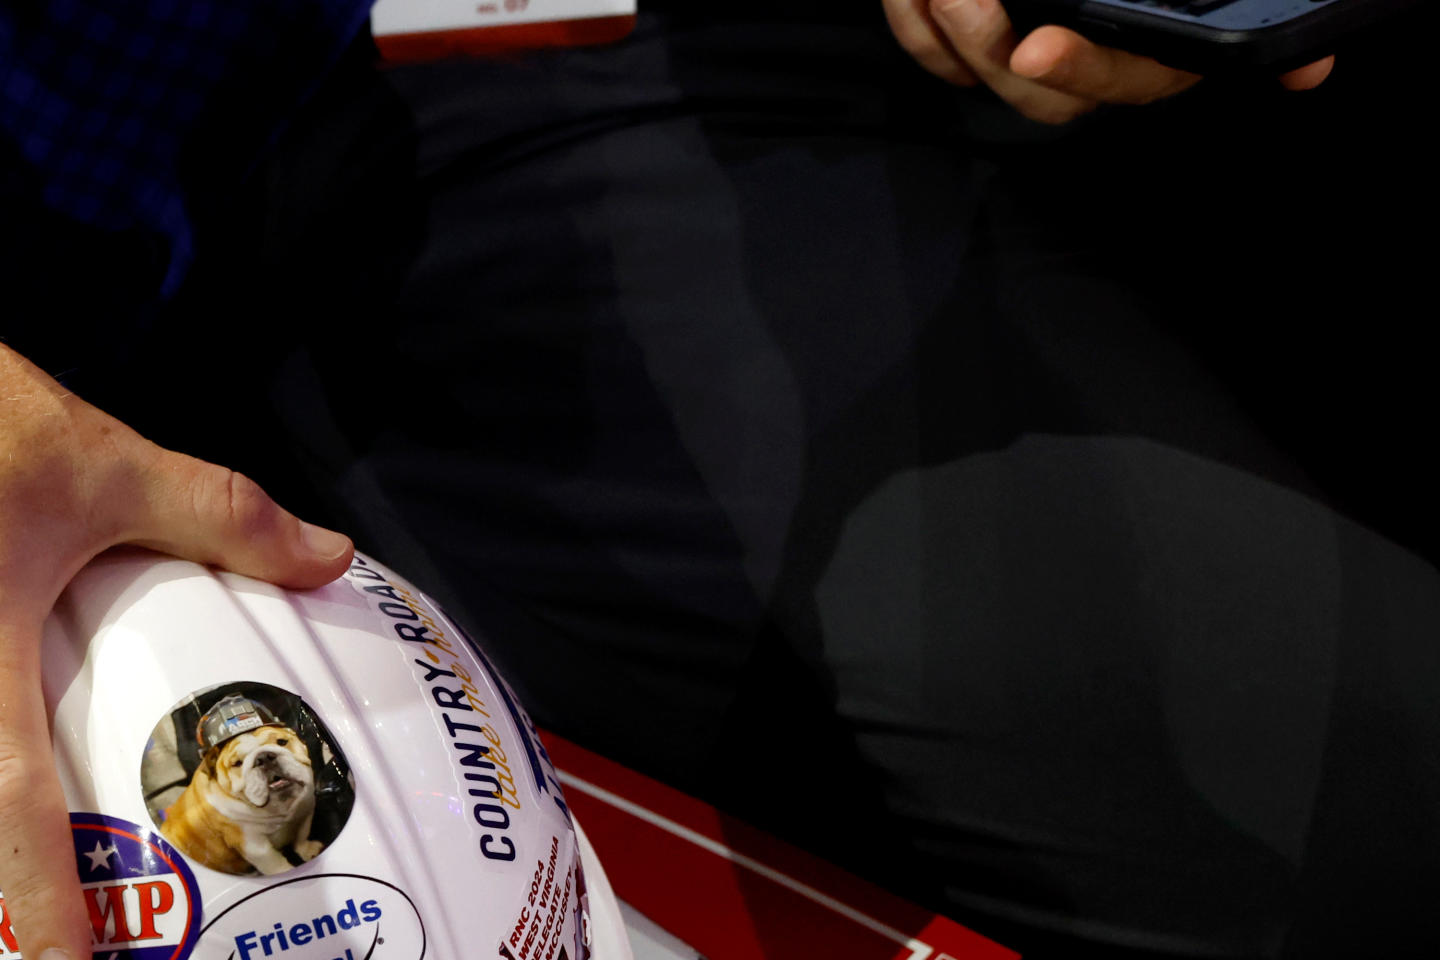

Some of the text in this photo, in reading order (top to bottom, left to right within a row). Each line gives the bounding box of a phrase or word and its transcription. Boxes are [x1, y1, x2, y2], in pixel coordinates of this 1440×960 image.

[351, 555, 516, 862] COUNTRY ROAD
[451, 661, 491, 718] me
[480, 722, 521, 810] take
[510, 860, 544, 948] RNC 2024
[518, 836, 559, 960] WEST VIRGINIA
